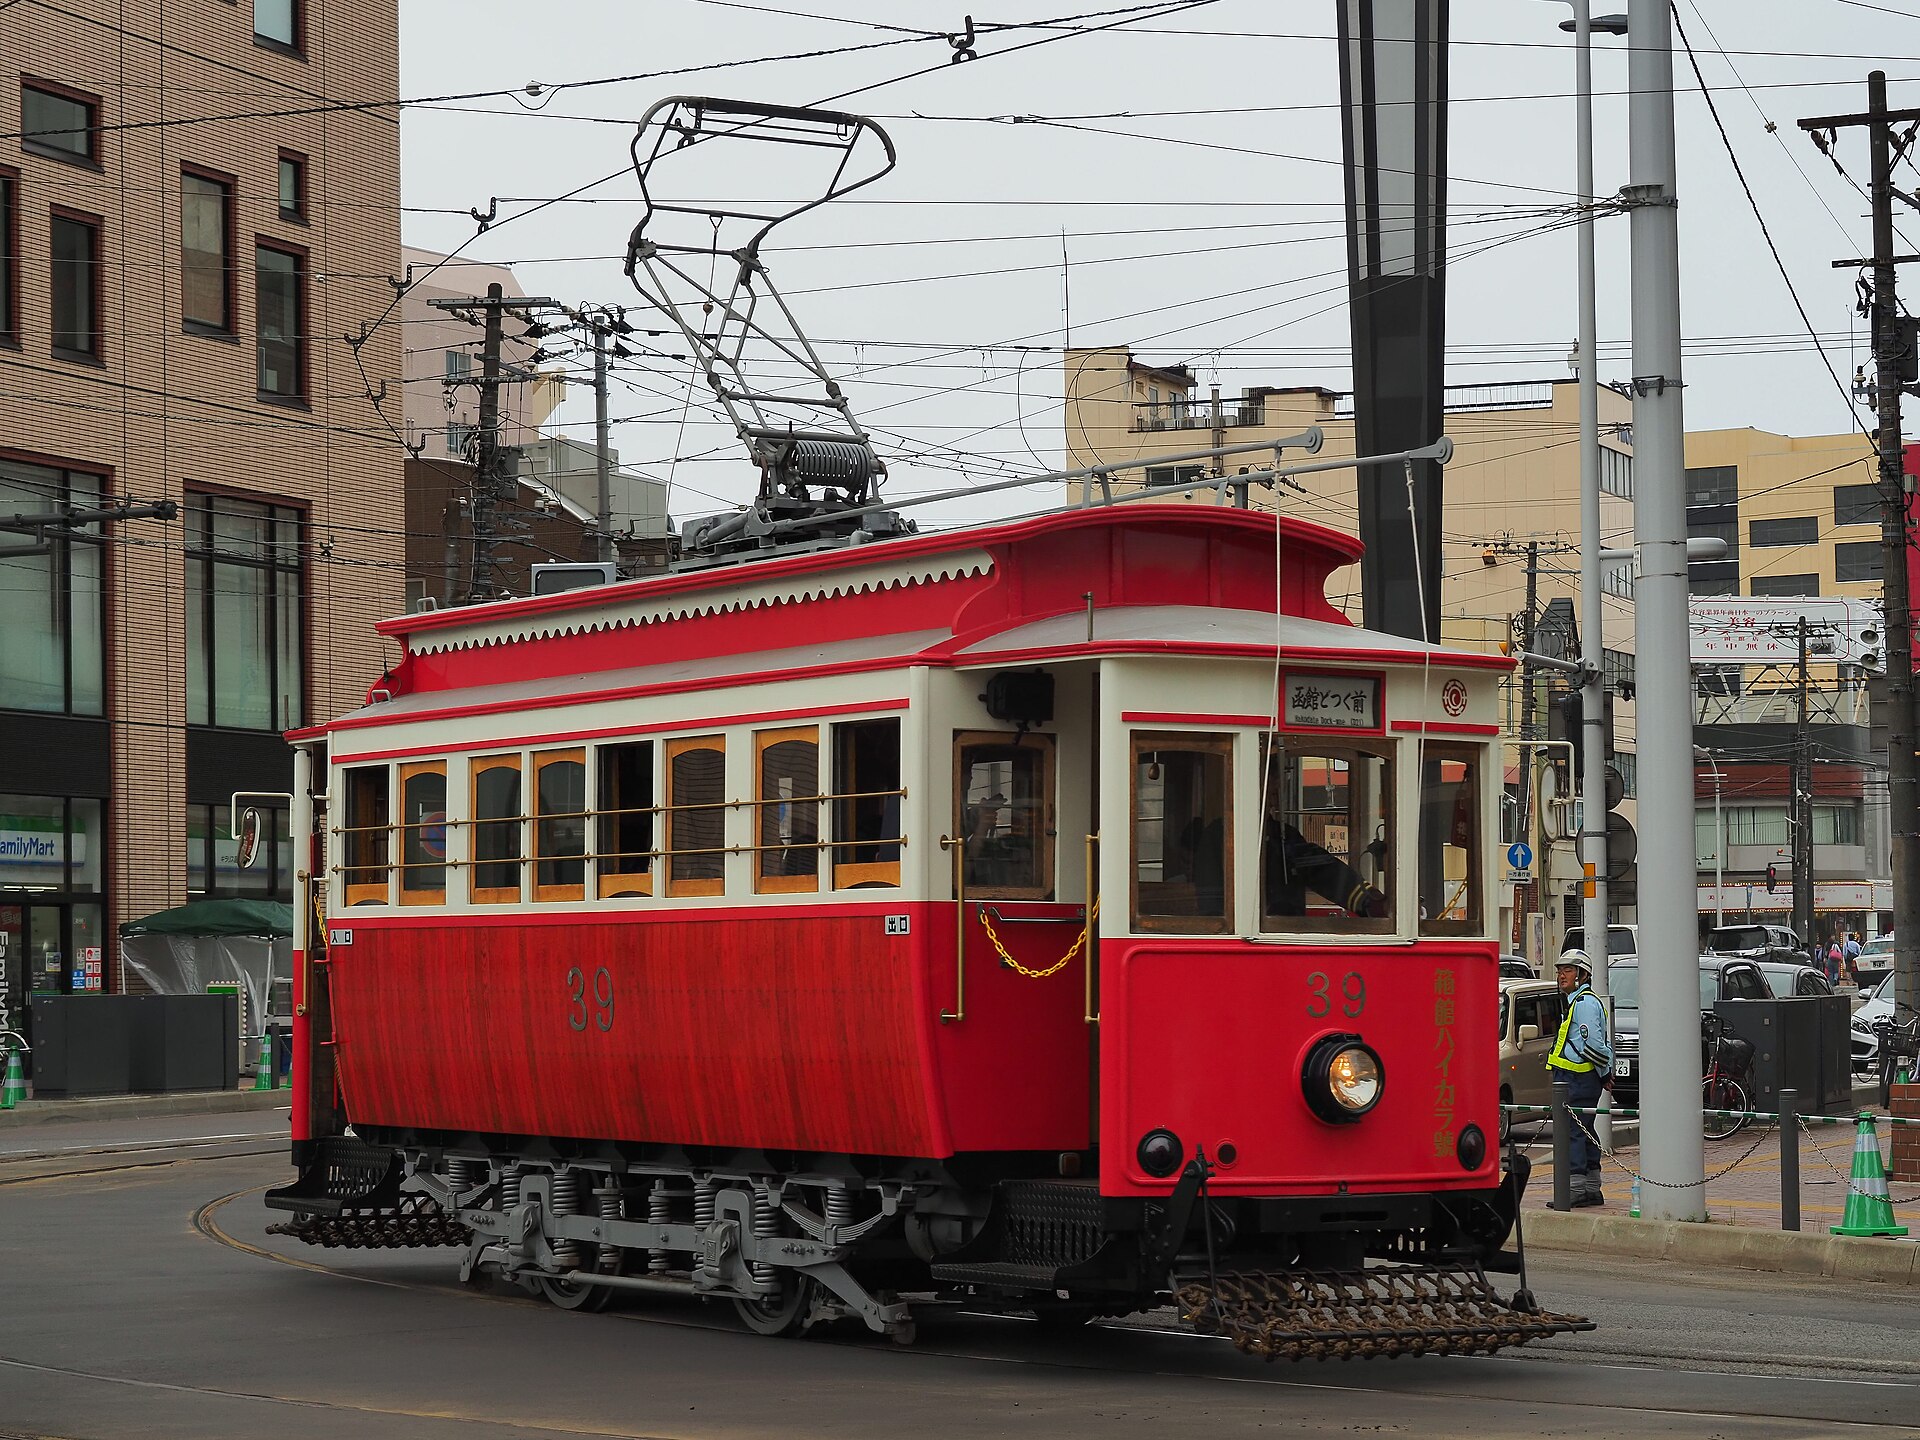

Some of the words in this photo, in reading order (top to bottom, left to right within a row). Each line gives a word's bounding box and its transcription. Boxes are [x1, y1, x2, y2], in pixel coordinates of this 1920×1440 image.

[1705, 642, 1779, 651] 年中無休
[888, 916, 908, 933] 出口
[331, 930, 351, 943] 入口
[567, 966, 614, 1032] 39
[1306, 971, 1367, 1018] 39
